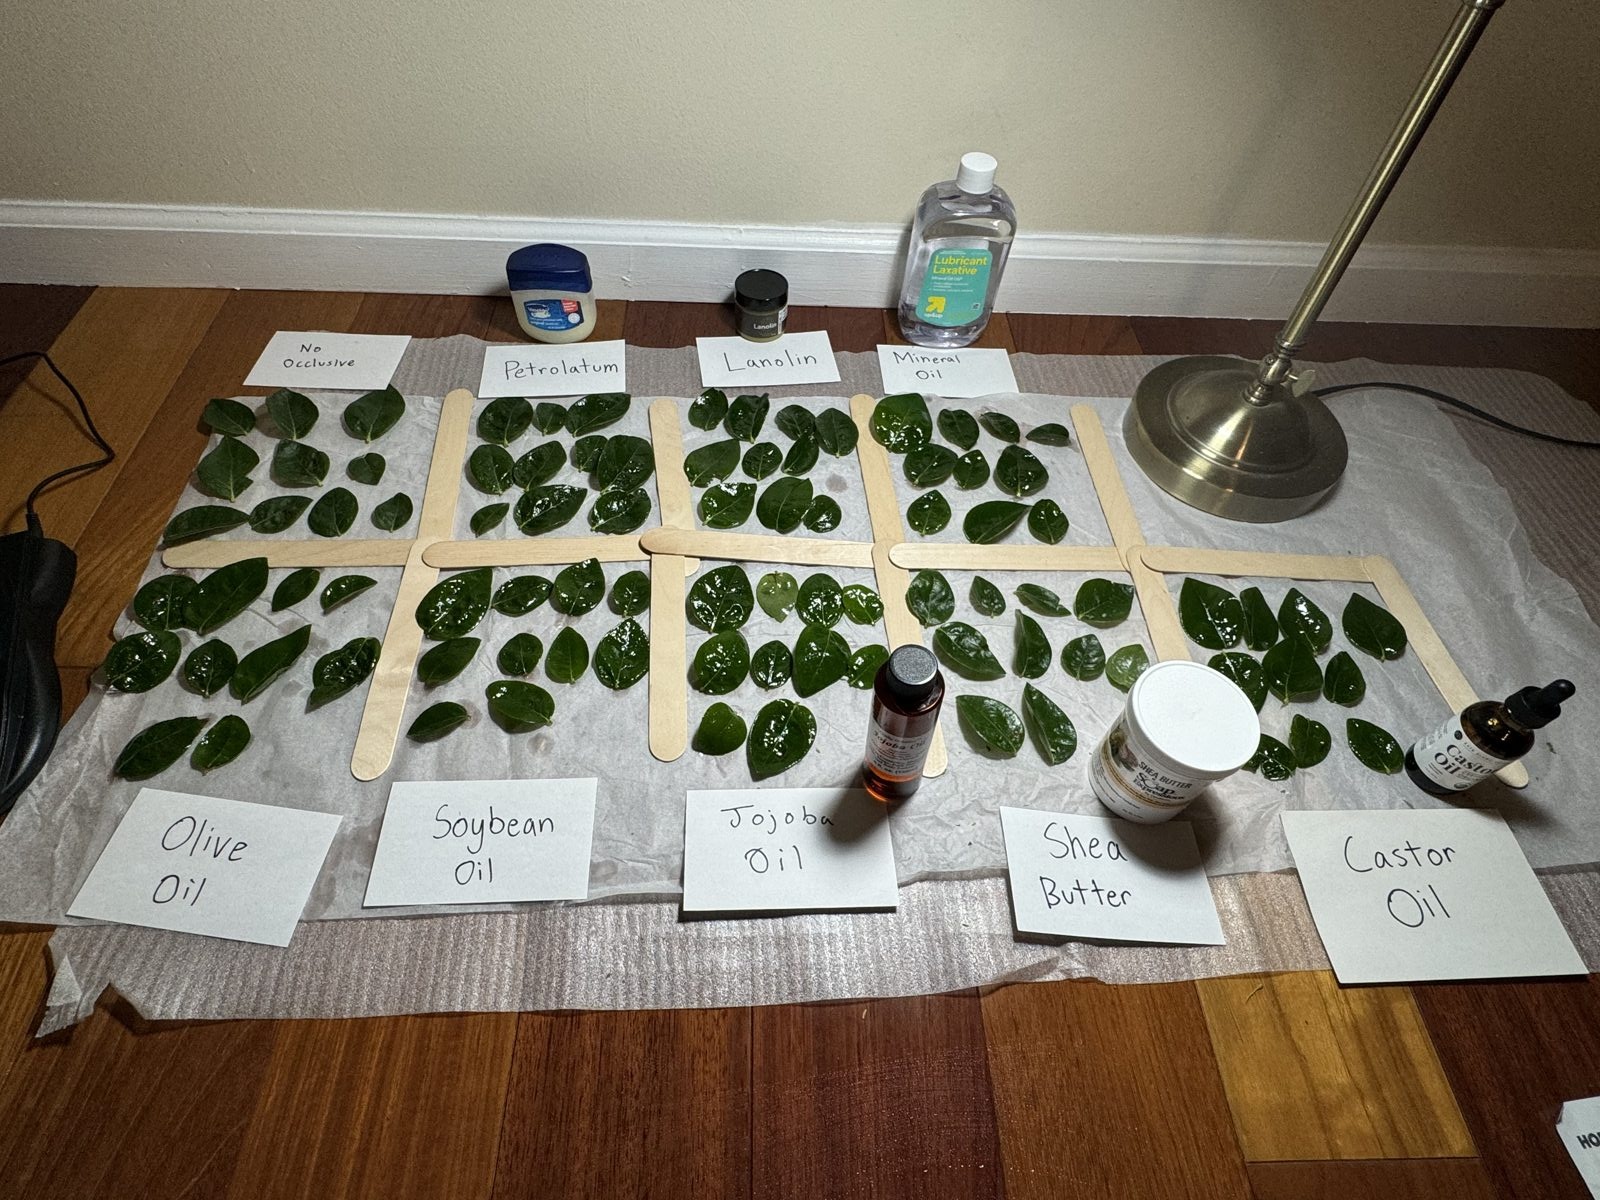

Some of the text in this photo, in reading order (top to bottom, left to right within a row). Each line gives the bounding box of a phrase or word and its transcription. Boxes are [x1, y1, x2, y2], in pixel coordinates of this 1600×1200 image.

[933, 264, 978, 275] Laxative
[934, 255, 987, 266] Lubricant
[753, 322, 777, 330] Lanolin
[300, 343, 322, 353] No
[724, 349, 817, 372] Lanolin
[893, 351, 961, 365] Mineral
[283, 357, 356, 369] Occlusive
[505, 358, 619, 381] Petrolatum
[915, 369, 943, 380] Oil
[1434, 752, 1461, 775] Oil
[1446, 744, 1493, 775] Casto
[1136, 772, 1176, 796] Soap
[1139, 761, 1159, 781] SHEA
[1159, 775, 1193, 789] BUTTER
[432, 803, 555, 855] Soybean
[720, 804, 835, 835] Jojoba
[161, 815, 248, 862] Olive
[1043, 821, 1128, 862] Shea
[744, 844, 803, 874] Oil
[1344, 835, 1456, 873] Castor
[454, 857, 494, 886] Oil
[152, 874, 207, 907] Oil
[1039, 875, 1132, 910] Butter
[1387, 884, 1451, 928] Oil
